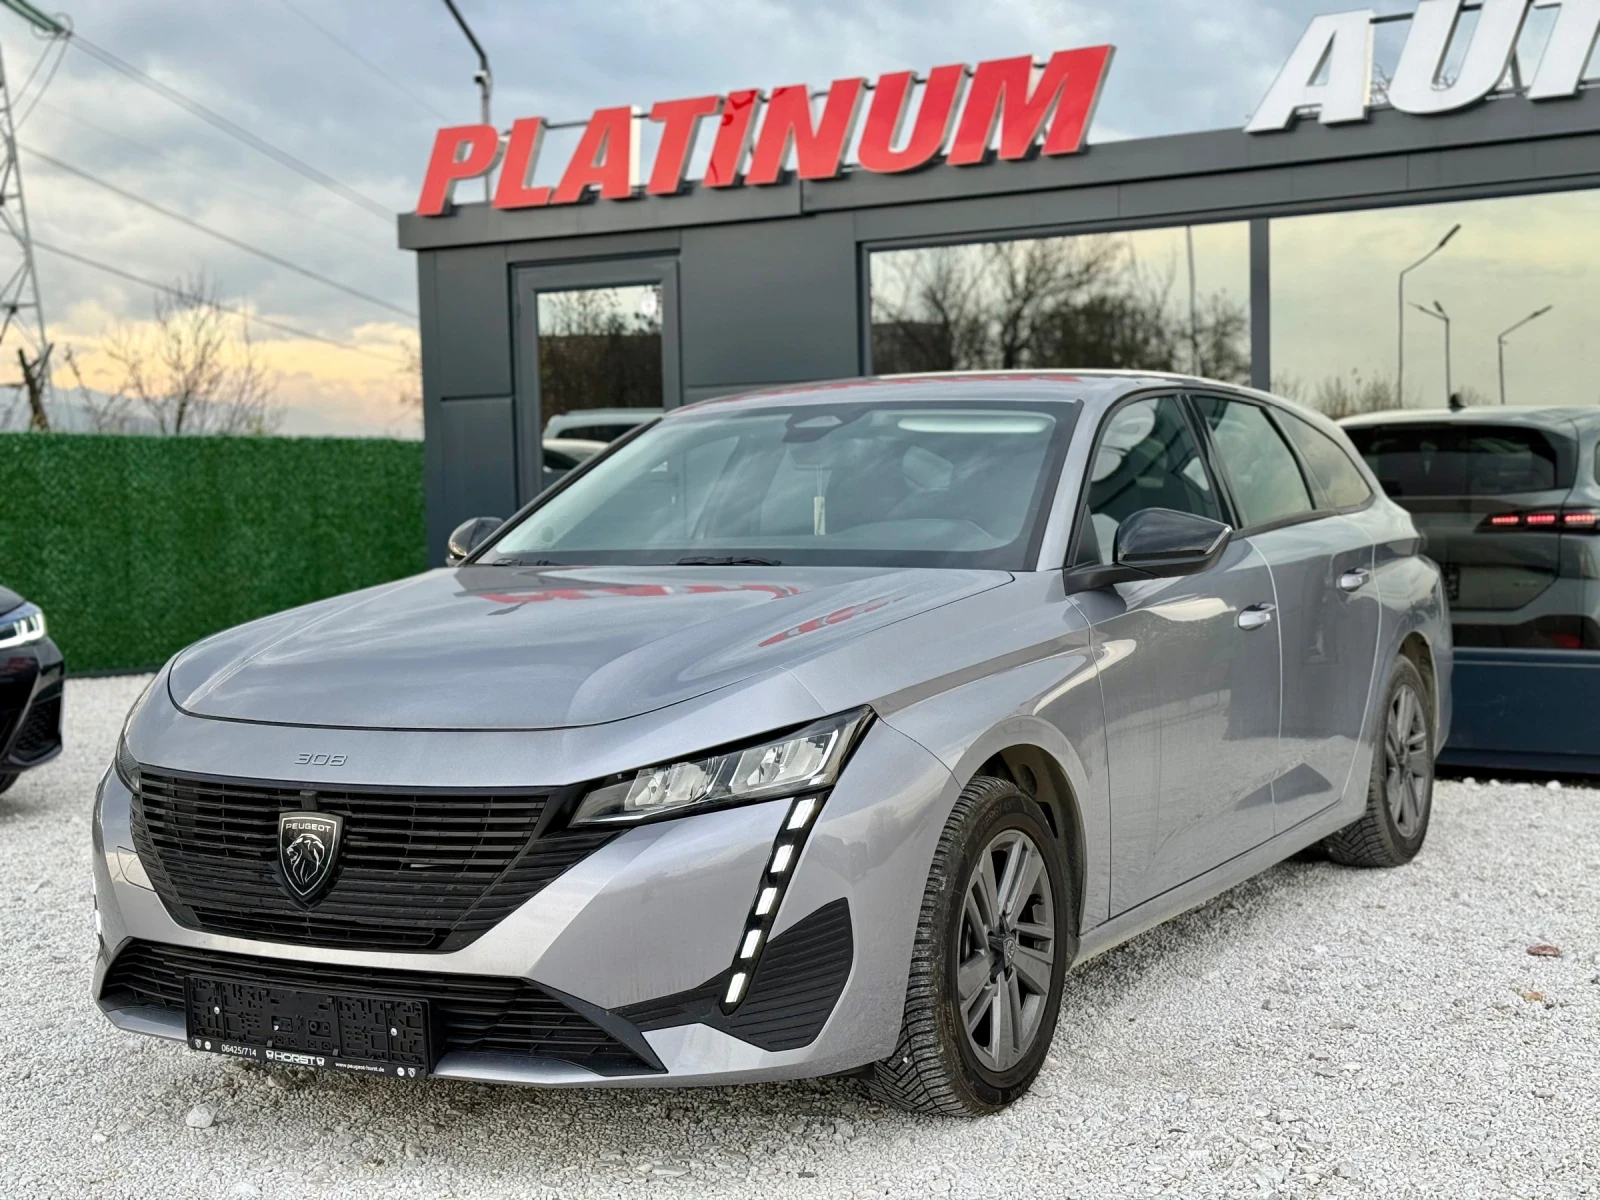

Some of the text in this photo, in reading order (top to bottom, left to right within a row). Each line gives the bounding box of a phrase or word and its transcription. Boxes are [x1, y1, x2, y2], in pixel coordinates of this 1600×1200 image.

[415, 44, 1115, 216] PLATINUM
[294, 752, 348, 766] 308
[285, 822, 332, 833] PEUGEOT
[221, 1044, 257, 1057] 06425/714
[274, 1051, 316, 1066] HORST
[334, 1062, 386, 1073] www.peugeot-horst.de
